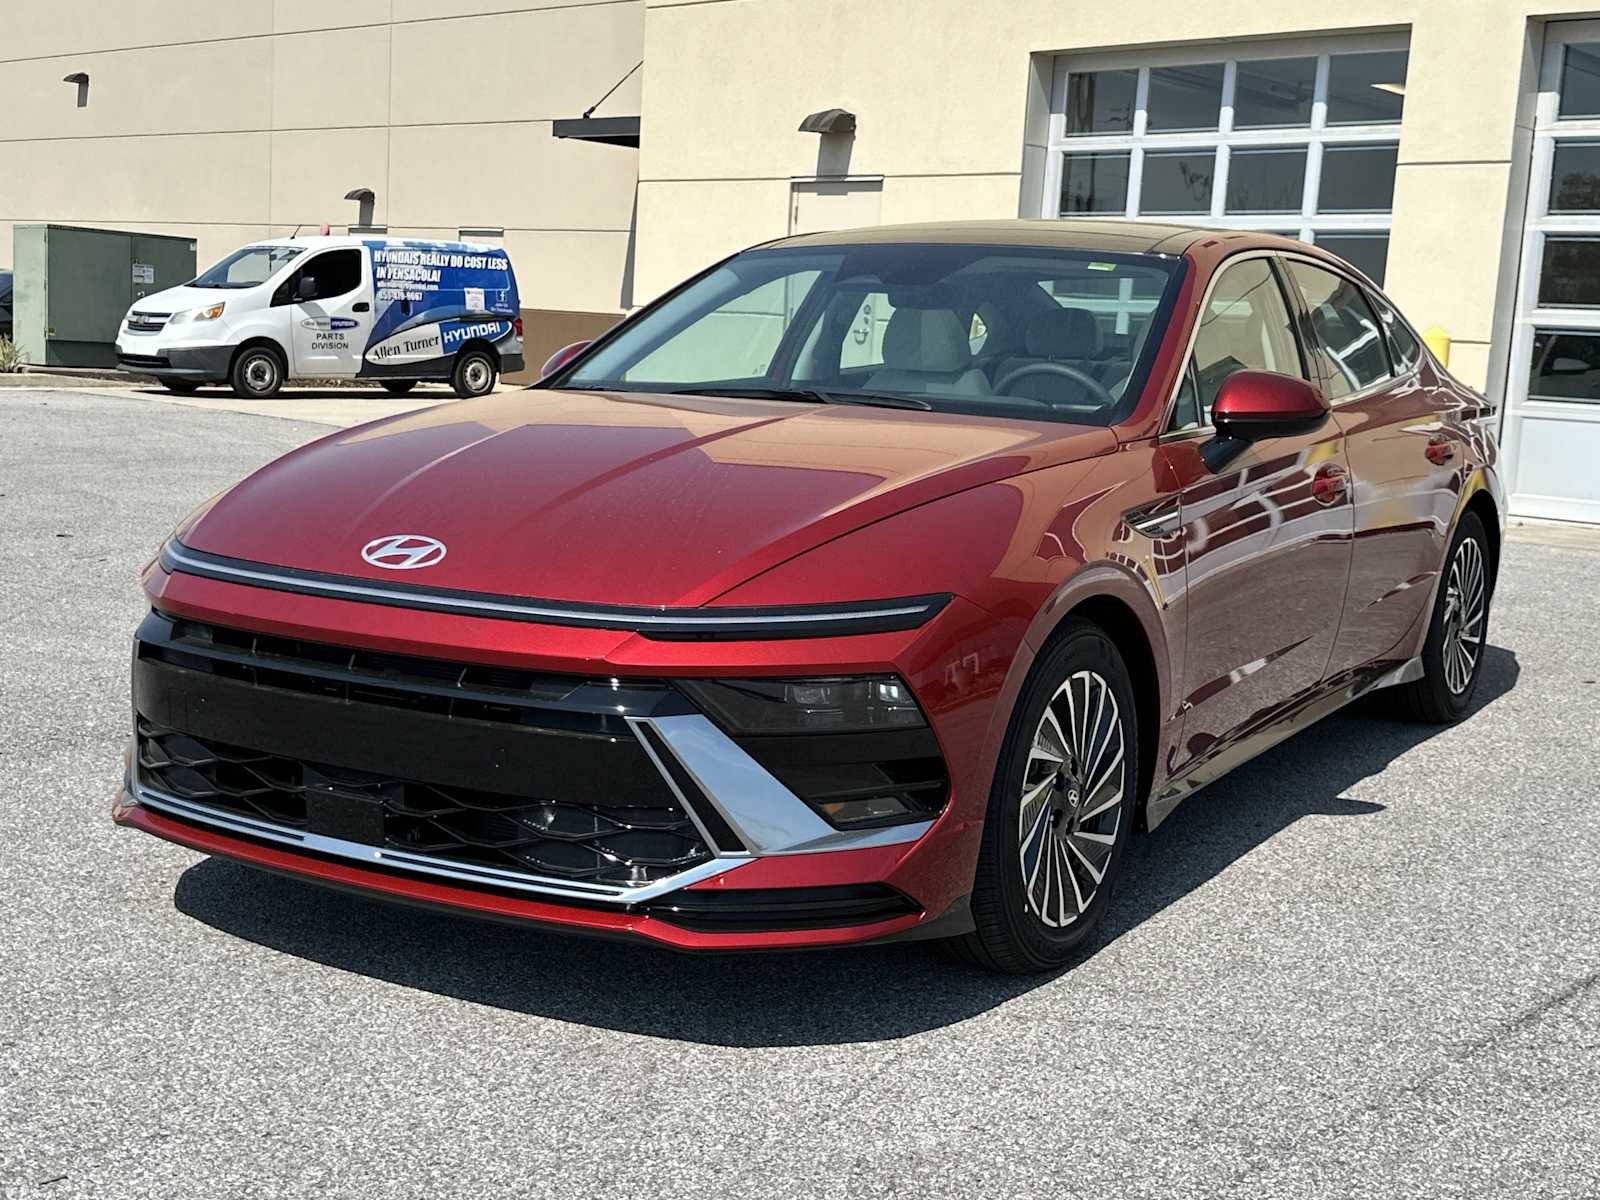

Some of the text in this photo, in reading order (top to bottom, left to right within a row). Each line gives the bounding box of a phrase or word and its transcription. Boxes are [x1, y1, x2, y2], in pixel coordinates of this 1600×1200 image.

[420, 253, 450, 267] REALLY
[450, 255, 463, 268] DO
[464, 256, 487, 269] COST
[487, 257, 508, 270] LESS
[376, 266, 387, 279] IN
[311, 342, 349, 350] DIVISION
[373, 321, 501, 361] Allen Turner HYUNDAI
